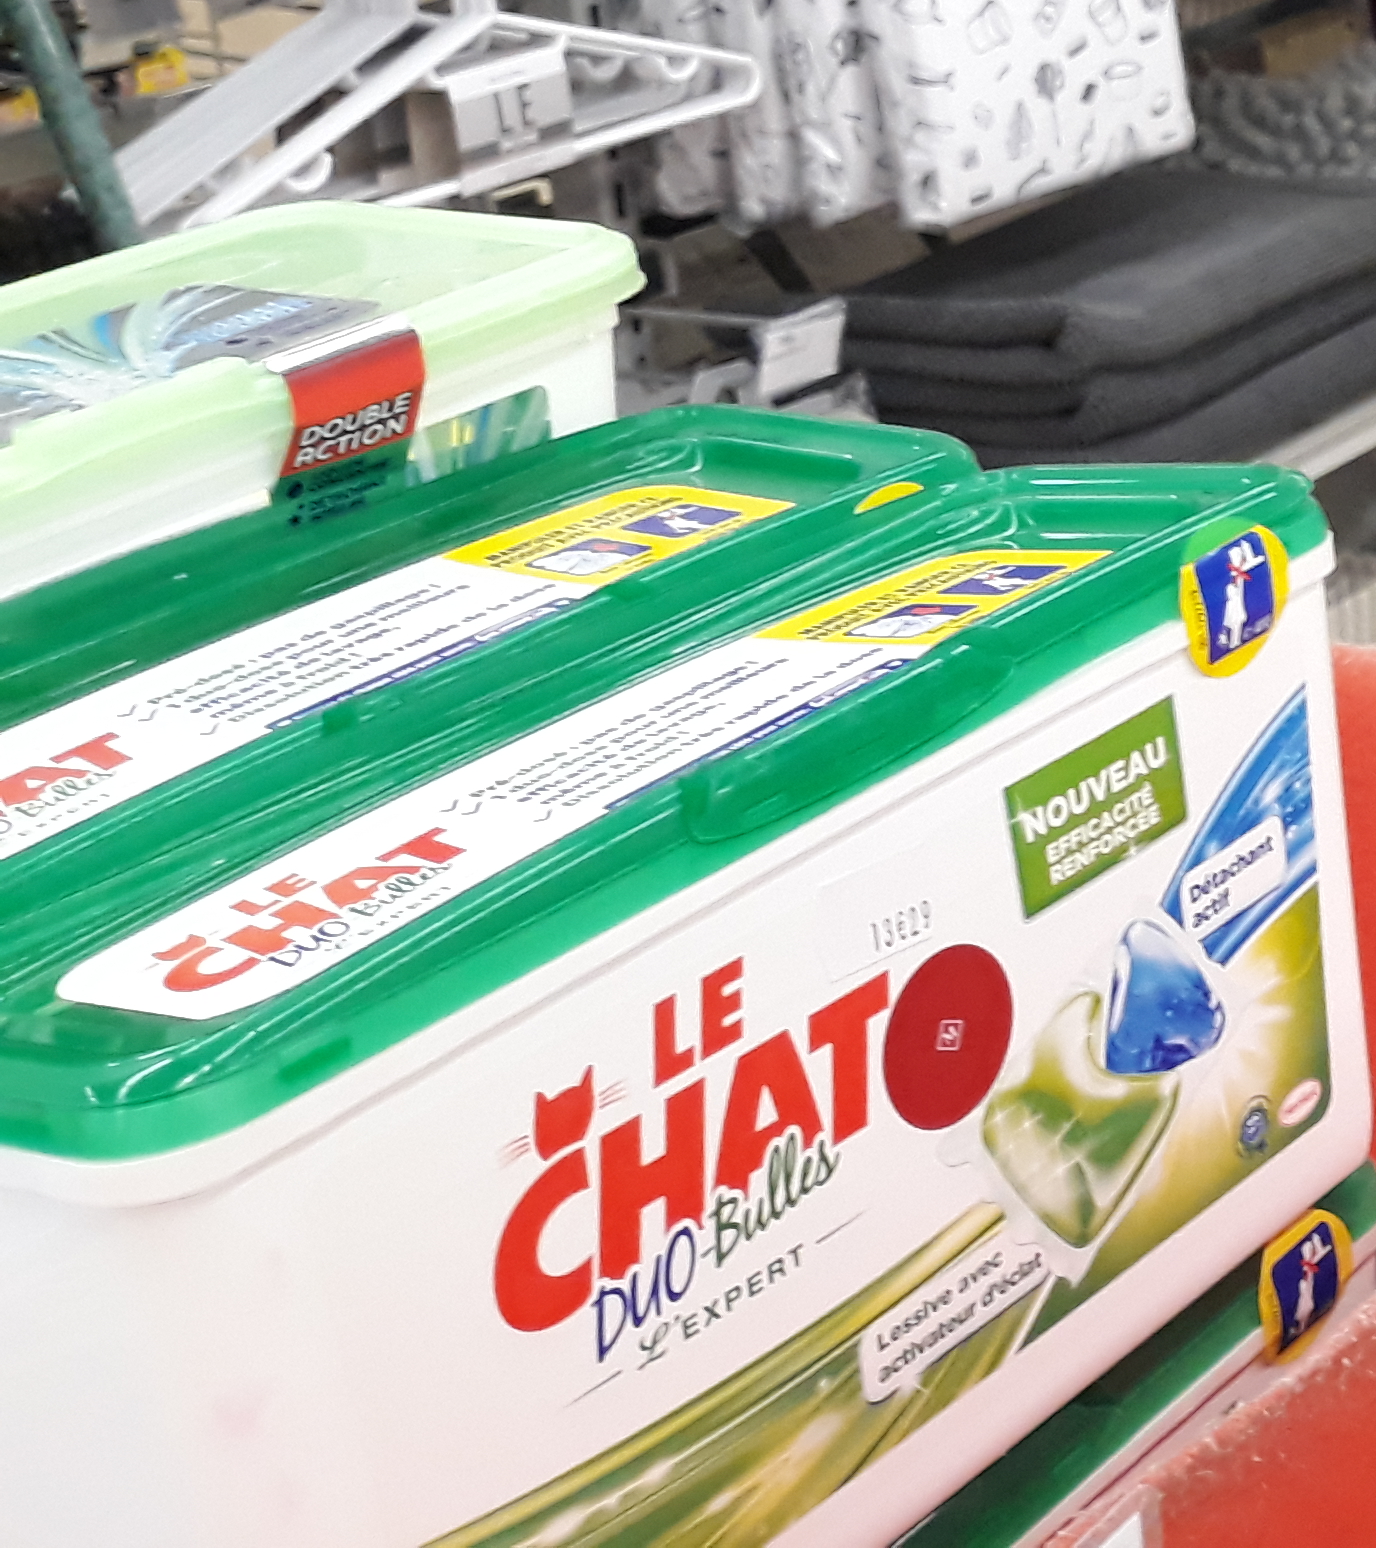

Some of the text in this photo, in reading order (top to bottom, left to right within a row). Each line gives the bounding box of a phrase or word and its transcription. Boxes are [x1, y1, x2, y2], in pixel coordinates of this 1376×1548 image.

[492, 82, 537, 133] LE
[292, 413, 409, 468] ACTION
[299, 392, 413, 447] DOUBLE
[0, 732, 133, 808] AT
[1018, 736, 1168, 844] NOUVEAU
[1044, 780, 1154, 863] EFFICACITÉ
[162, 826, 467, 992] CHAT
[229, 873, 317, 916] LE
[652, 955, 745, 1089] LE
[493, 969, 890, 1333] CHAT
[636, 1243, 805, 1372] L'EXPERT
[875, 1250, 1003, 1352] Lessive avec
[878, 1301, 978, 1384] activateur
